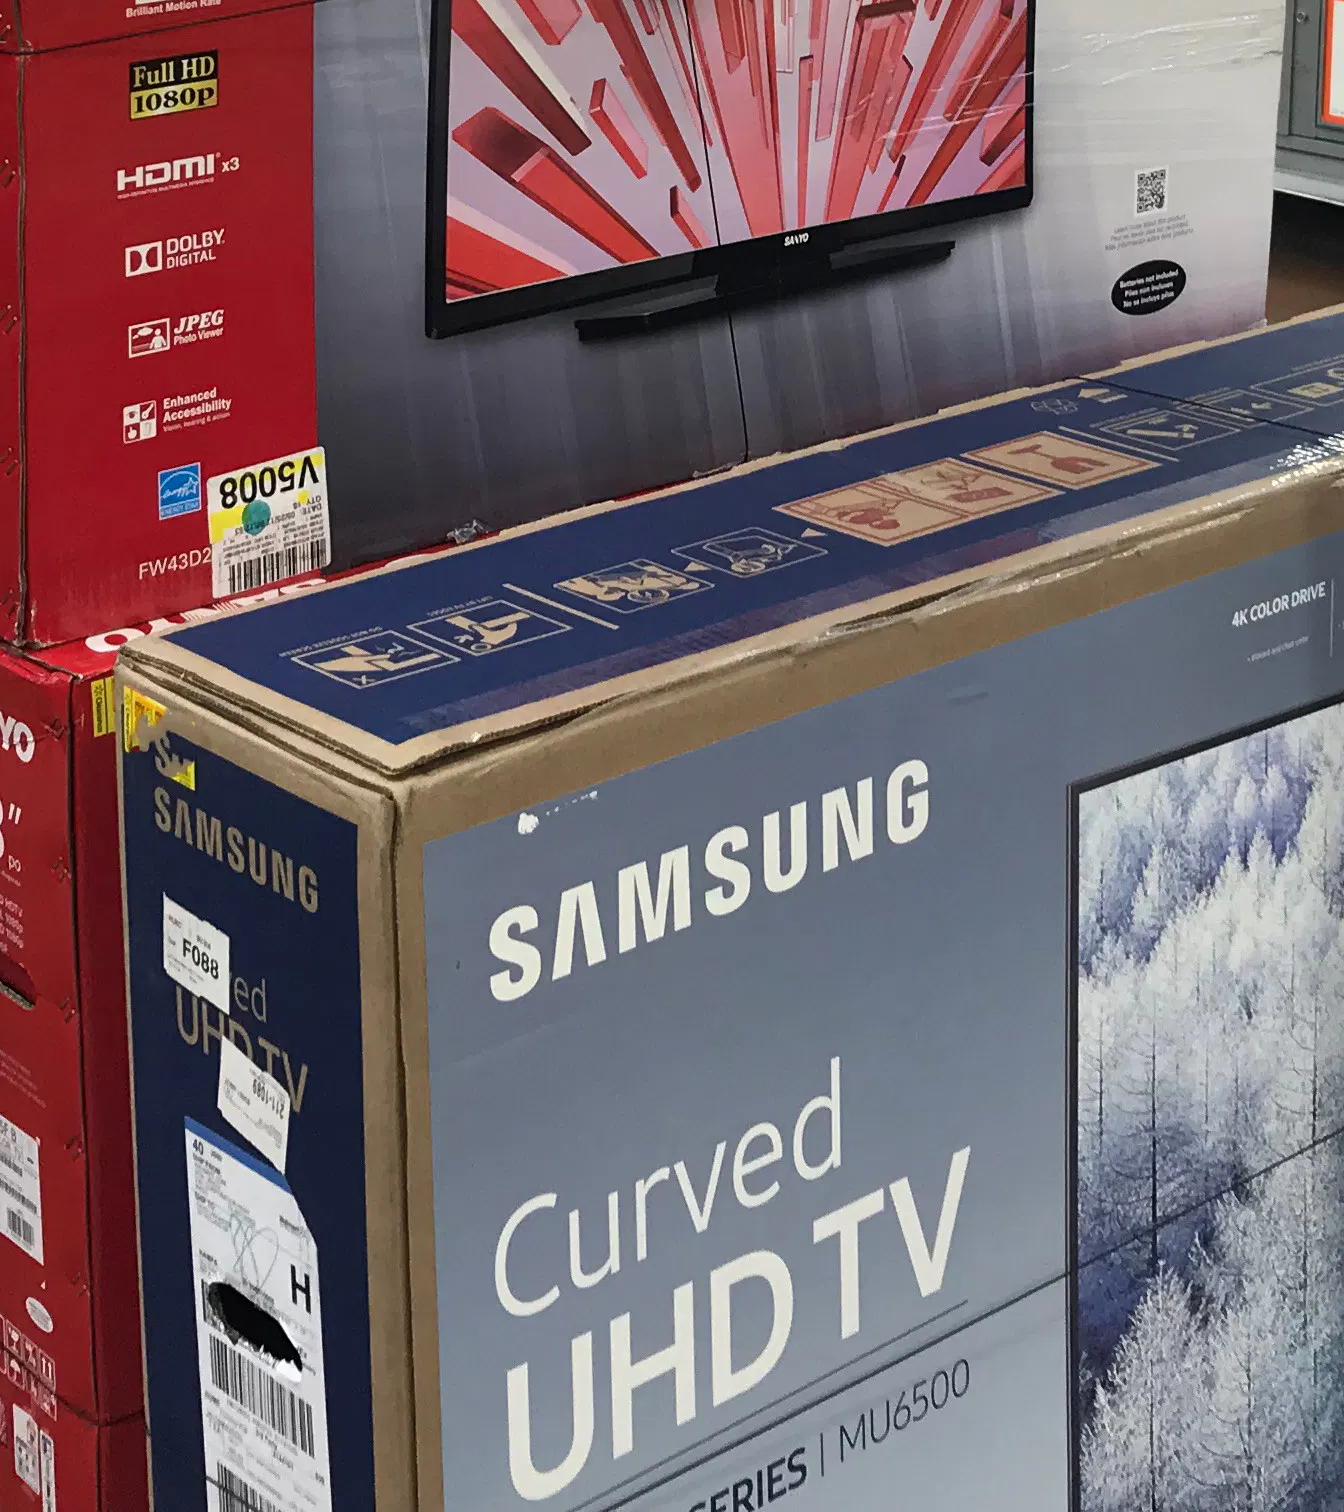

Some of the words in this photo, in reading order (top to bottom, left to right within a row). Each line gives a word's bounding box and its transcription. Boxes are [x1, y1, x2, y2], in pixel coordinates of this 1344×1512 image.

[126, 3, 163, 18] Brilliant
[165, 0, 198, 13] Motion
[132, 59, 175, 88] Full
[181, 55, 216, 81] HD
[134, 85, 215, 115] 1080p
[116, 152, 215, 192] HDMI
[166, 228, 225, 256] DOLBY
[783, 232, 810, 247] SANYO
[166, 248, 217, 270] DIGITAL
[173, 332, 197, 347] Photo
[197, 326, 224, 343] Viewer
[174, 308, 225, 337] JPEG
[162, 386, 218, 410] Enhanced
[162, 397, 233, 424] Accessibility
[219, 454, 320, 511] V5008
[1231, 609, 1249, 628] 4K
[1250, 595, 1290, 622] COLOR
[1291, 580, 1327, 608] DRIVE
[154, 785, 320, 915] SAMSUNG
[487, 757, 931, 1003] SAMSUNG
[492, 1054, 844, 1319] Curved
[290, 1262, 312, 1315] H
[505, 1248, 796, 1504] UHD
[812, 1143, 973, 1342] TV
[839, 1358, 971, 1464] MU6500
